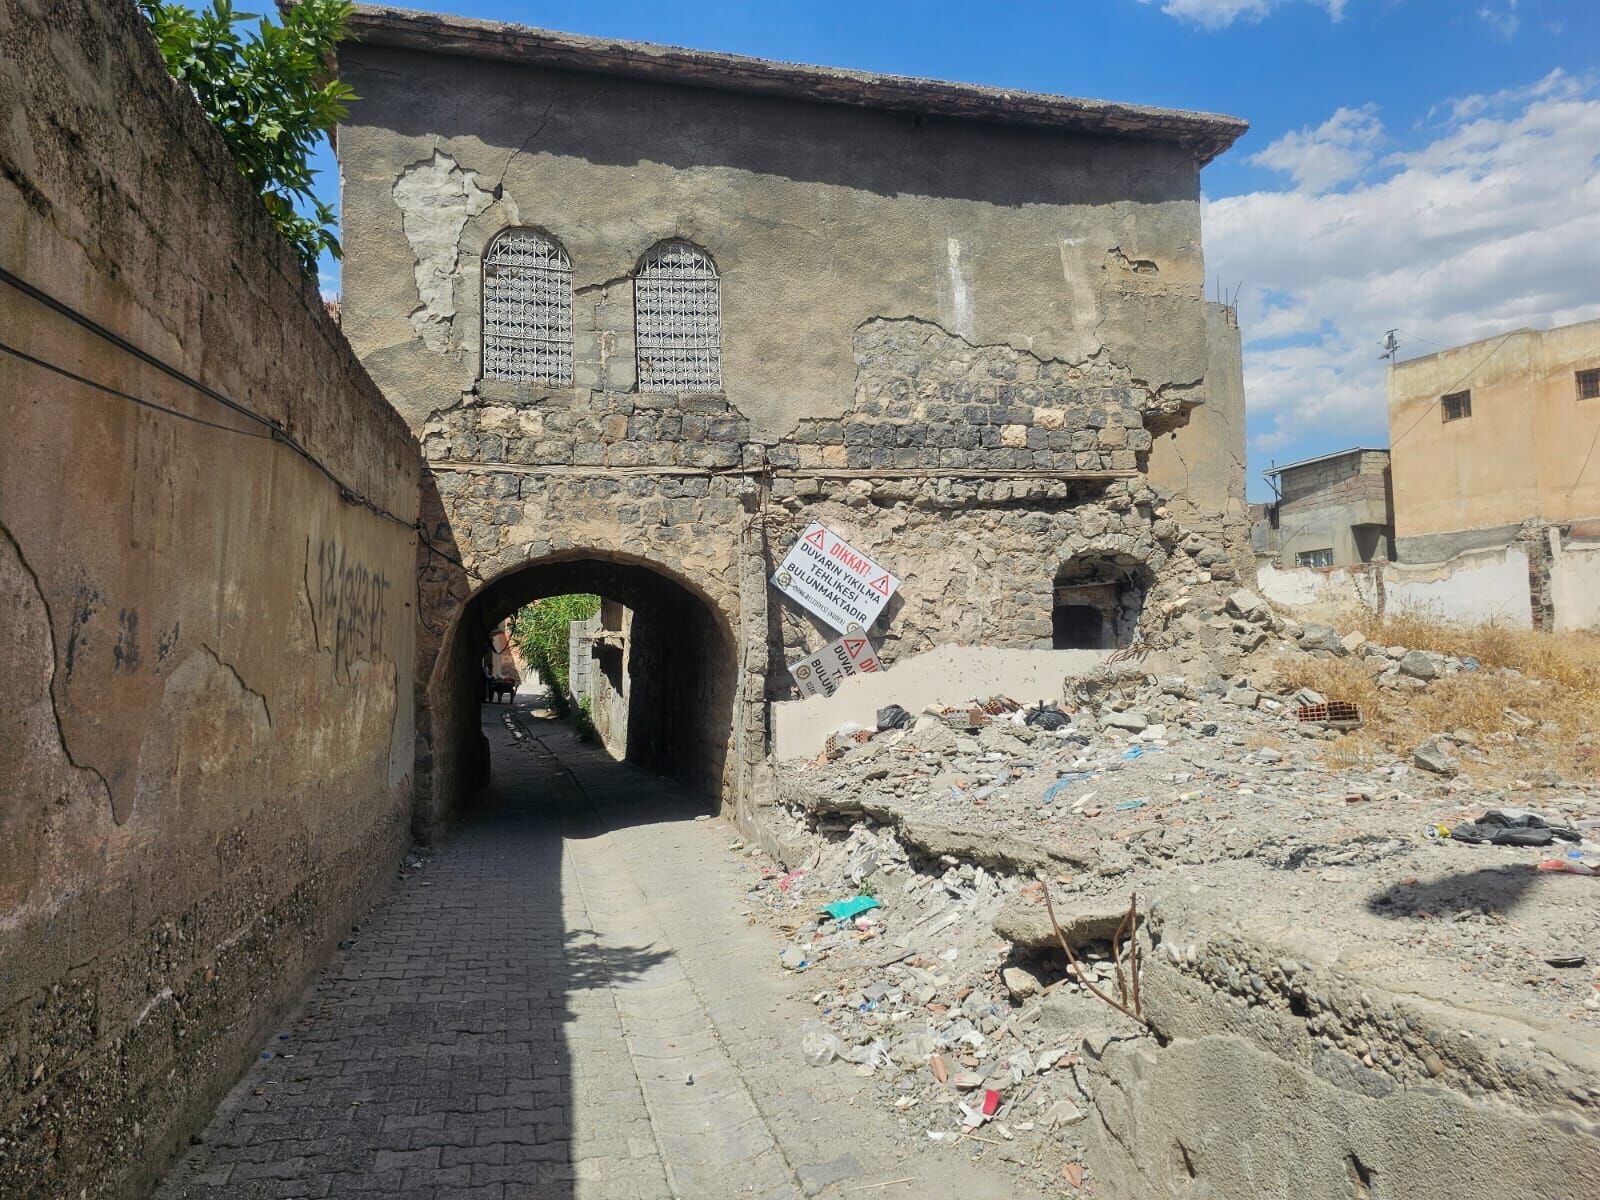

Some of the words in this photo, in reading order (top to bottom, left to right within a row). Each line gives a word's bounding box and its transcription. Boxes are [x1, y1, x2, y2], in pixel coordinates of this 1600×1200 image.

[800, 542, 842, 576] DUVARIN
[843, 572, 880, 604] YIKILMA
[810, 564, 859, 602] TEHLİKESİ
[830, 543, 872, 577] DİKKAT!
[787, 563, 867, 623] BULUNMAKTADIR
